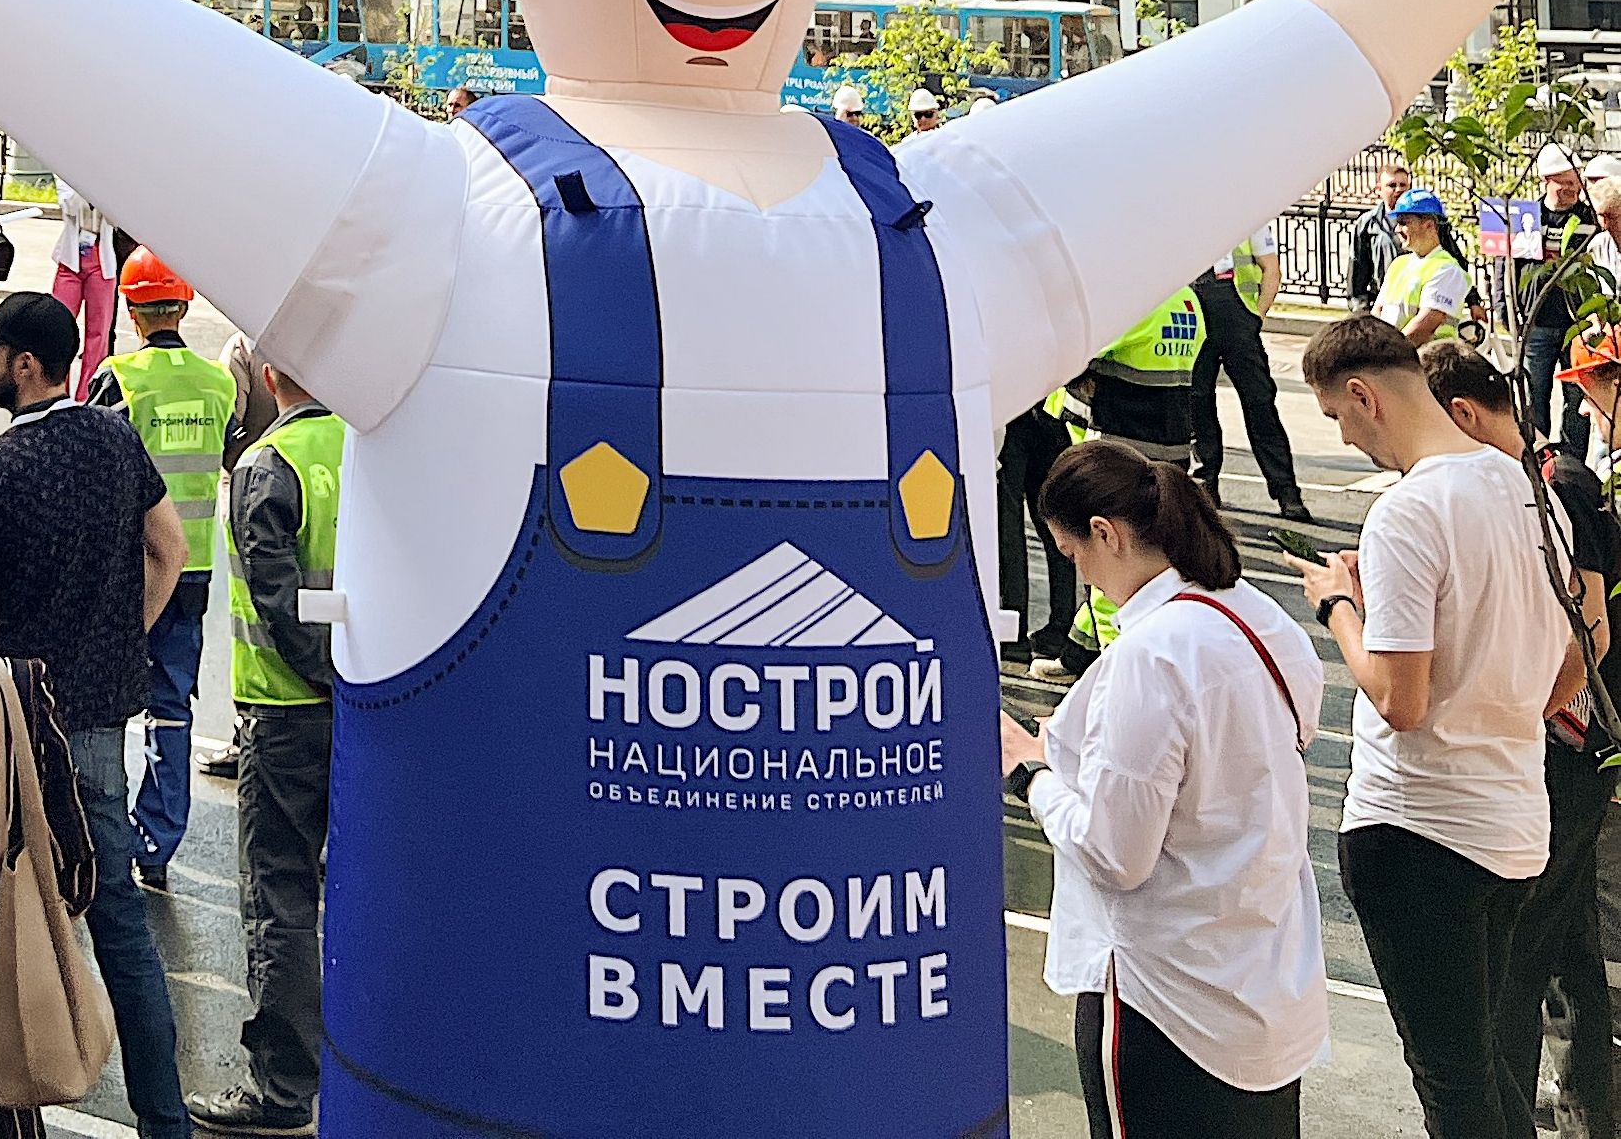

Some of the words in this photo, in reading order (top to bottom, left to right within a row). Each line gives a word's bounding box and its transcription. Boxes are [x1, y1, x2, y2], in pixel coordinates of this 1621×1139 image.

[465, 78, 516, 92] МАГАЗИН
[588, 639, 942, 732] НОСТРОЙ
[589, 737, 944, 782] НАЦИОНАЛЬНОЕ
[589, 781, 792, 811] ОБЪЕДИНЕНИЕ
[807, 780, 944, 810] СТРОИТЕЛЕЙ
[589, 866, 947, 942] СТРОИМ
[589, 952, 949, 1032] ВМЕСТЕ
